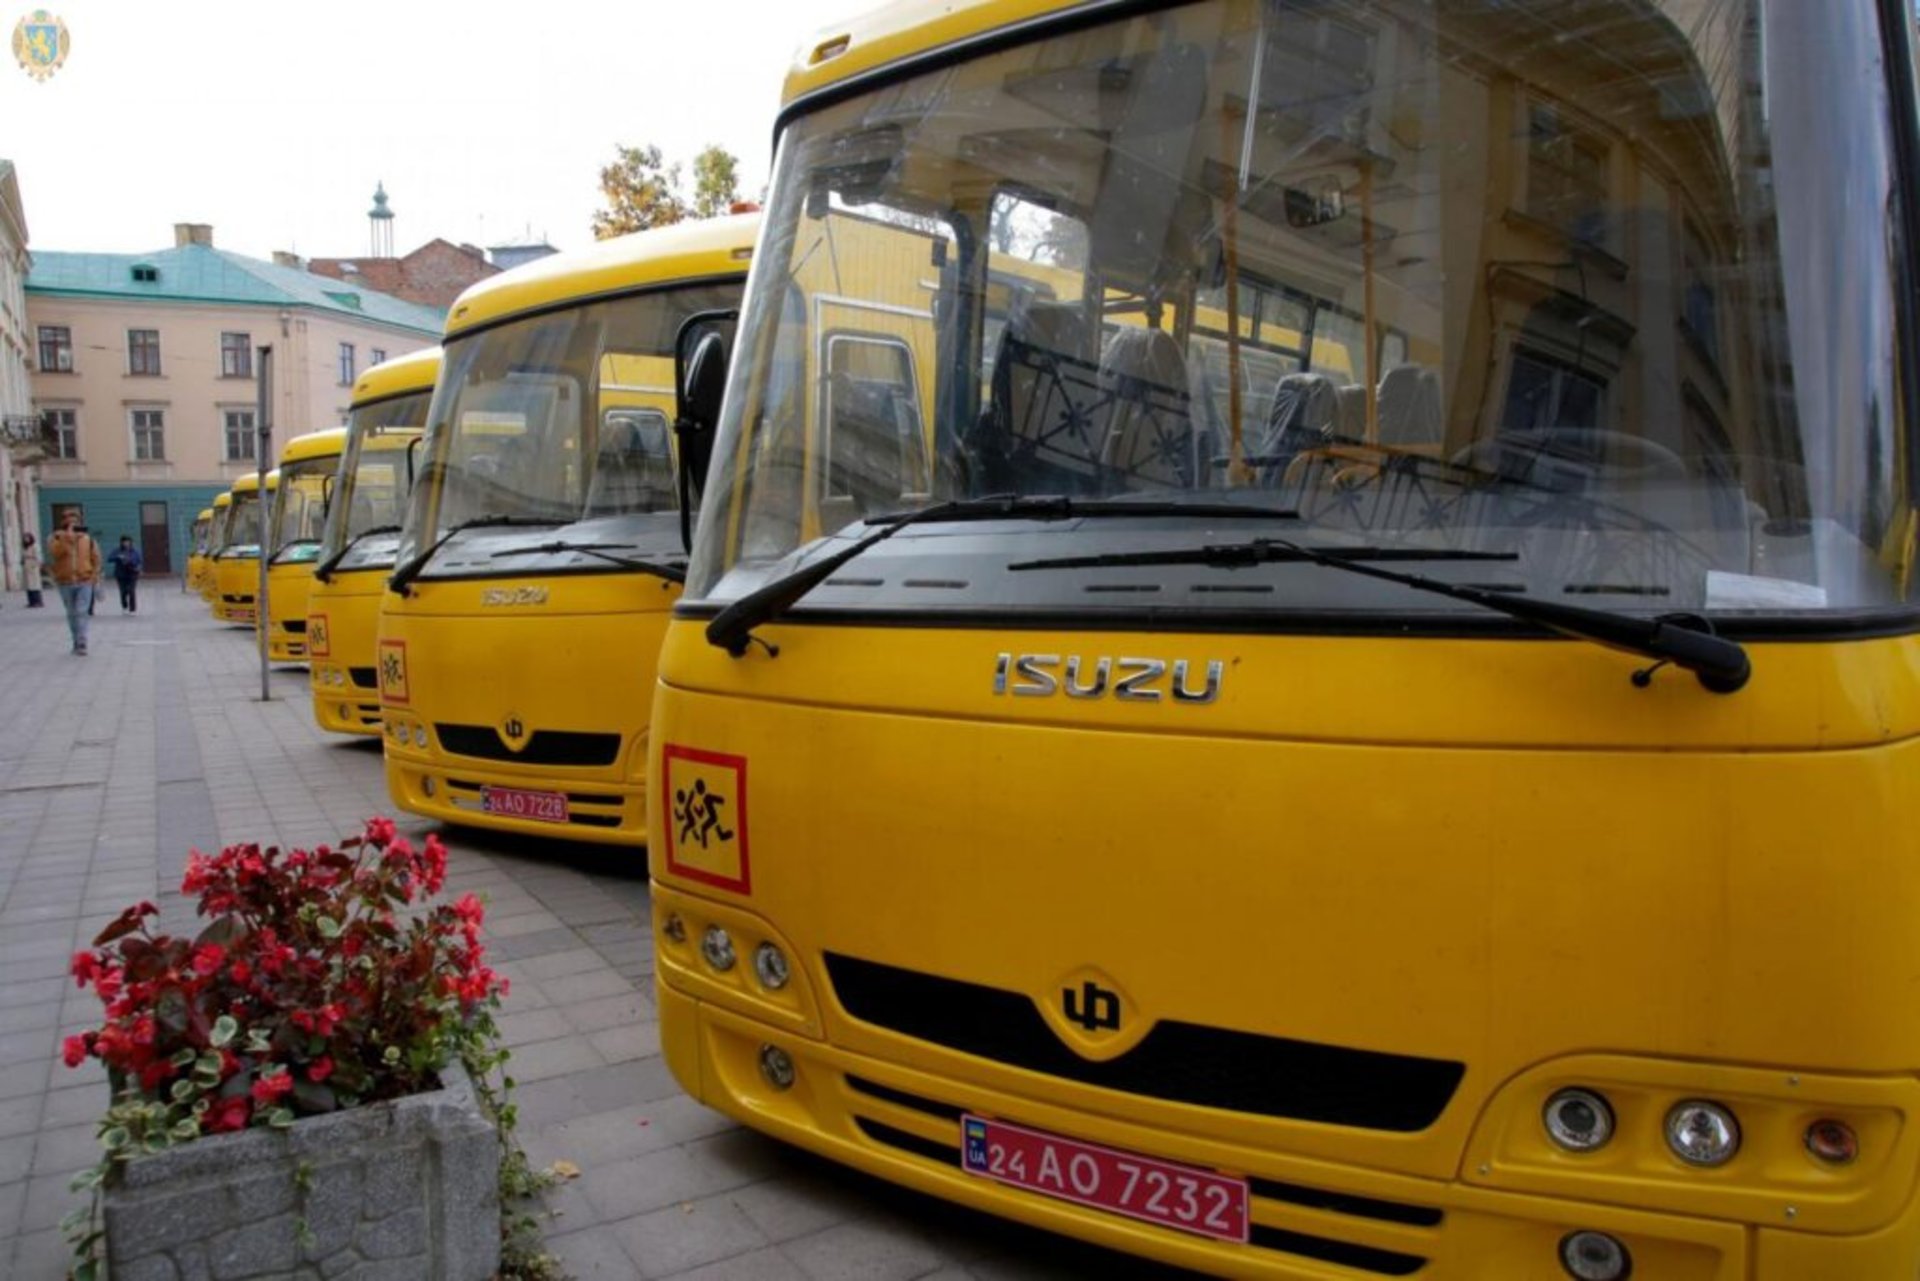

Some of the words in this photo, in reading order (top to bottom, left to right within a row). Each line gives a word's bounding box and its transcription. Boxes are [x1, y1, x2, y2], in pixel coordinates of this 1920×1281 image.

[993, 652, 1224, 703] ISUZU
[969, 1149, 986, 1166] UA
[989, 1144, 1025, 1180] 24
[1037, 1146, 1101, 1196] AO
[1117, 1163, 1229, 1230] 7232
